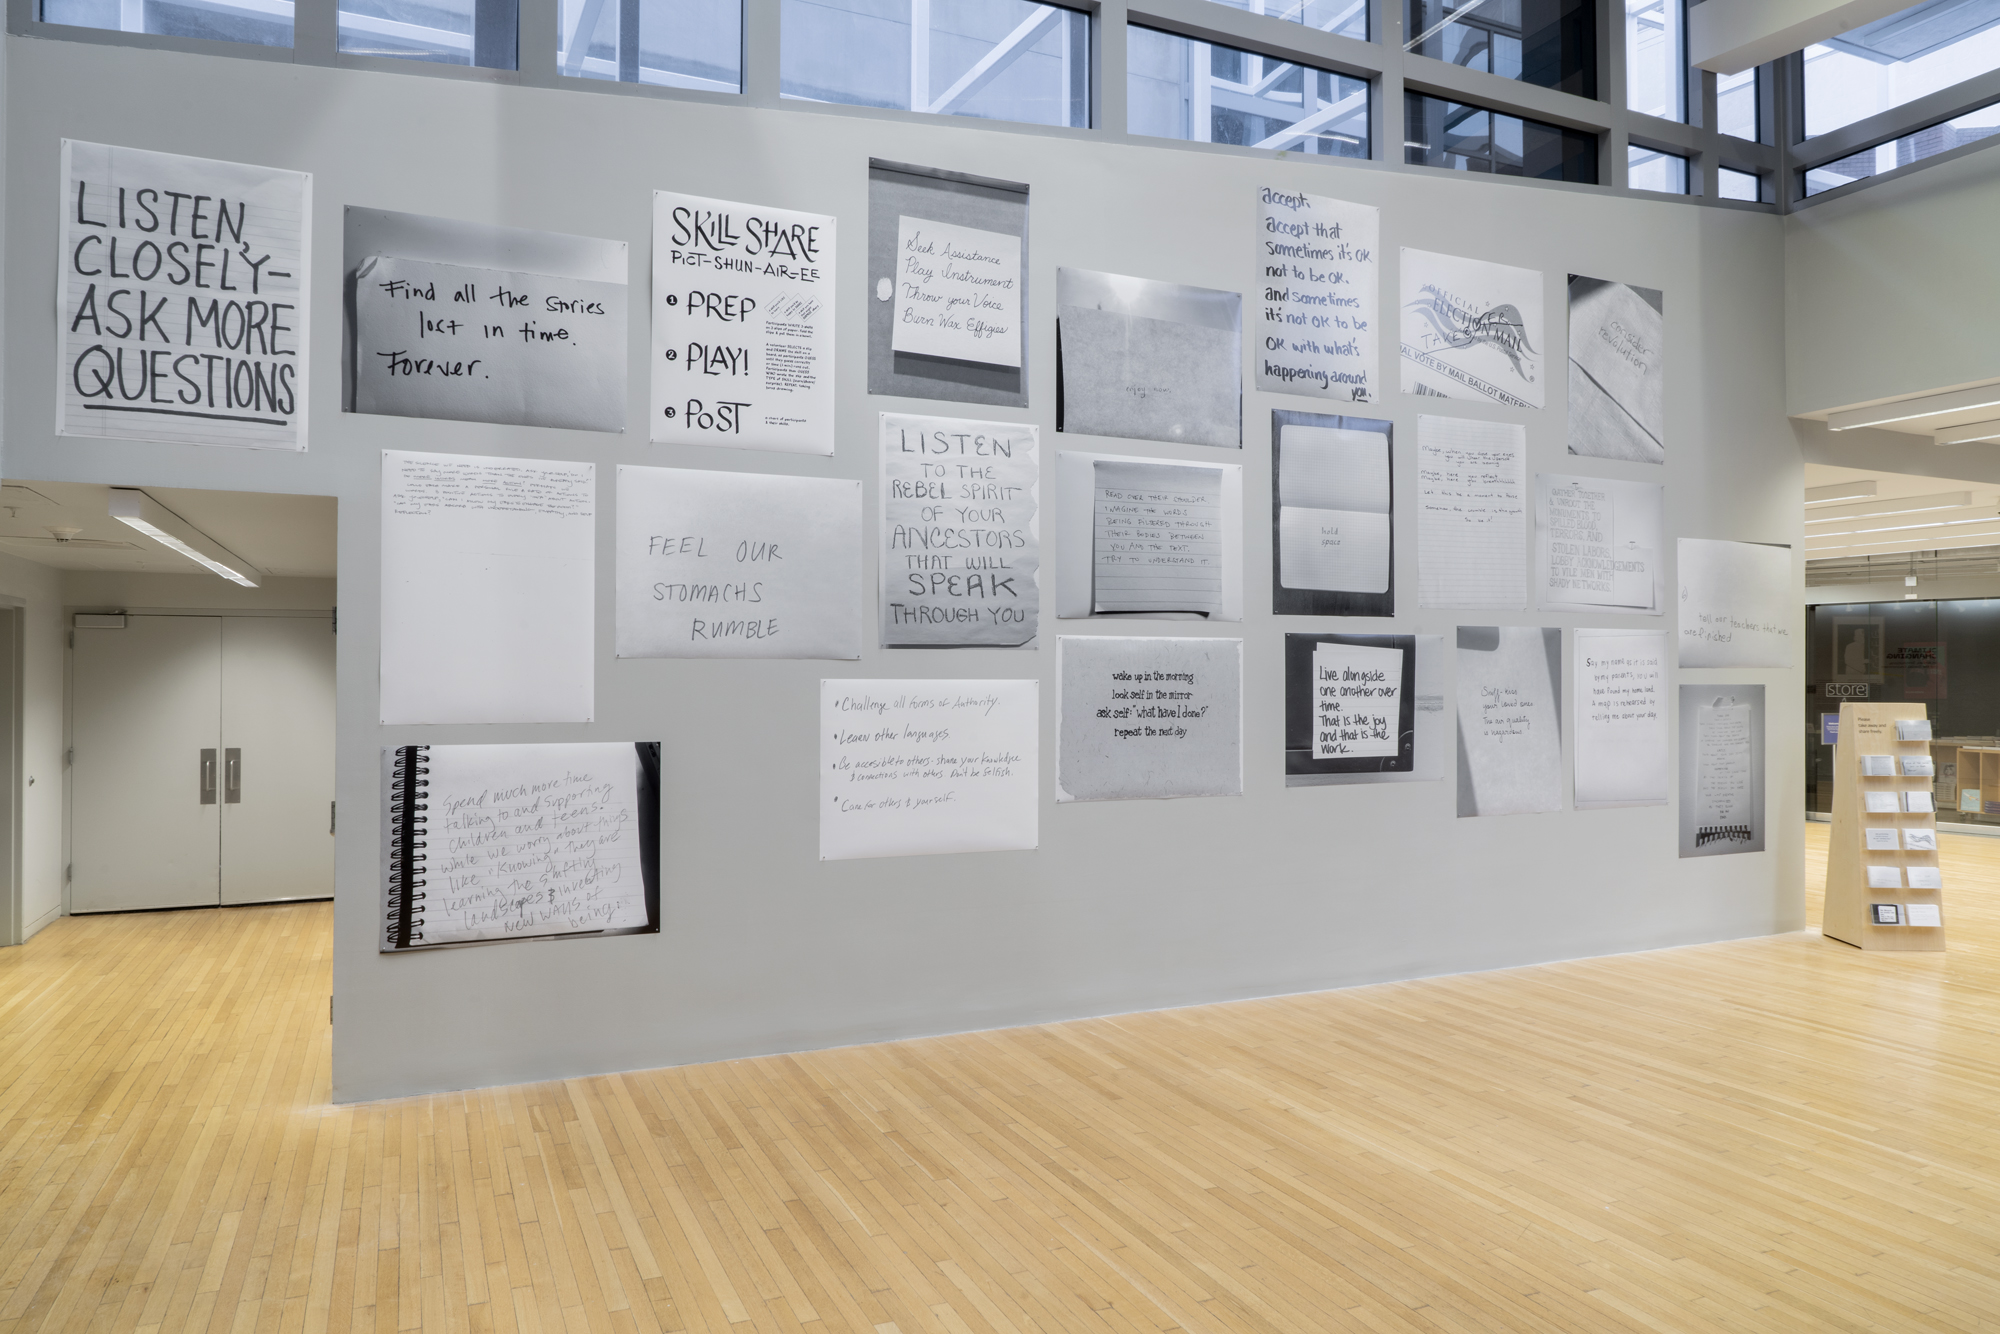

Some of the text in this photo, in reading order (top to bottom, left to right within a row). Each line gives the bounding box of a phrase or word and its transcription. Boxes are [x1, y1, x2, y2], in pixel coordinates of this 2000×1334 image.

[77, 180, 250, 254] LISTEN,
[1265, 216, 1343, 239] accept that
[745, 217, 821, 263] SHARE
[905, 231, 1001, 265] Seek Assistance
[1337, 242, 1353, 261] it's
[1355, 249, 1373, 263] OK
[905, 256, 1014, 289] Play Instrument
[1265, 264, 1288, 278] not
[1292, 265, 1305, 280] to
[1309, 267, 1326, 283] be
[379, 280, 436, 302] Find
[454, 284, 476, 303] all
[490, 286, 529, 308] the
[666, 294, 678, 306] 1
[902, 282, 1004, 311] Throw your Voice
[1265, 287, 1360, 308] and sometimes
[1428, 284, 1480, 315] OFFICIAL
[686, 290, 756, 322] PREP
[71, 283, 296, 355] ASK MORE
[419, 311, 576, 346] lost in time.
[902, 307, 1009, 338] Burn Wax Effigies
[1265, 307, 1368, 331] it's not OK to be
[1265, 336, 1360, 356] OK with what's
[1420, 331, 1460, 349] TAKE
[1493, 328, 1524, 353] MAIL
[1598, 320, 1655, 375] consider revolution
[376, 350, 489, 379] Forever.
[665, 349, 677, 361] 2
[686, 342, 749, 376] PLAY!
[73, 344, 295, 415] QUESTIONS
[1264, 359, 1367, 389] happening around
[1414, 351, 1435, 367] VOTE
[1436, 362, 1447, 372] BY
[1448, 367, 1467, 383] MAIL
[1467, 377, 1500, 397] BALLOT
[1126, 384, 1146, 399] enjoy
[1351, 387, 1372, 401] you.
[664, 406, 676, 418] 3
[901, 429, 1012, 458] LISTEN
[920, 463, 997, 479] TO THE
[892, 479, 1023, 500] REBEL SPIRIT
[921, 505, 1005, 523] OF YOUR
[892, 524, 1025, 549] ANCESTORS
[1321, 527, 1341, 547] hold space
[649, 535, 783, 562] FEEL OUR
[905, 554, 1014, 570] THAT WILL
[653, 582, 763, 603] STOMACHS
[908, 572, 1018, 598] SPEAK
[890, 603, 1025, 625] THROUGH YOU
[1699, 613, 1712, 624] tell
[1730, 616, 1759, 631] teachers
[1763, 623, 1777, 634] that
[691, 618, 780, 641] RUMBLE
[1112, 670, 1194, 685] wake up in the morning
[1319, 665, 1386, 686] Live alongside
[1112, 689, 1193, 700] look self in the mirror
[1320, 685, 1397, 697] one another over
[842, 695, 890, 715] Challenge
[894, 695, 906, 708] all
[909, 695, 935, 709] forms
[939, 698, 950, 707] of
[1096, 706, 1112, 718] ask
[1157, 706, 1176, 718] have
[1319, 700, 1343, 712] time.
[1319, 713, 1387, 730] That is the joy
[1114, 726, 1142, 739] repeat
[1144, 726, 1156, 736] the
[1174, 726, 1187, 739] day
[1320, 728, 1390, 742] and that is the
[443, 770, 593, 816] Spend much more time
